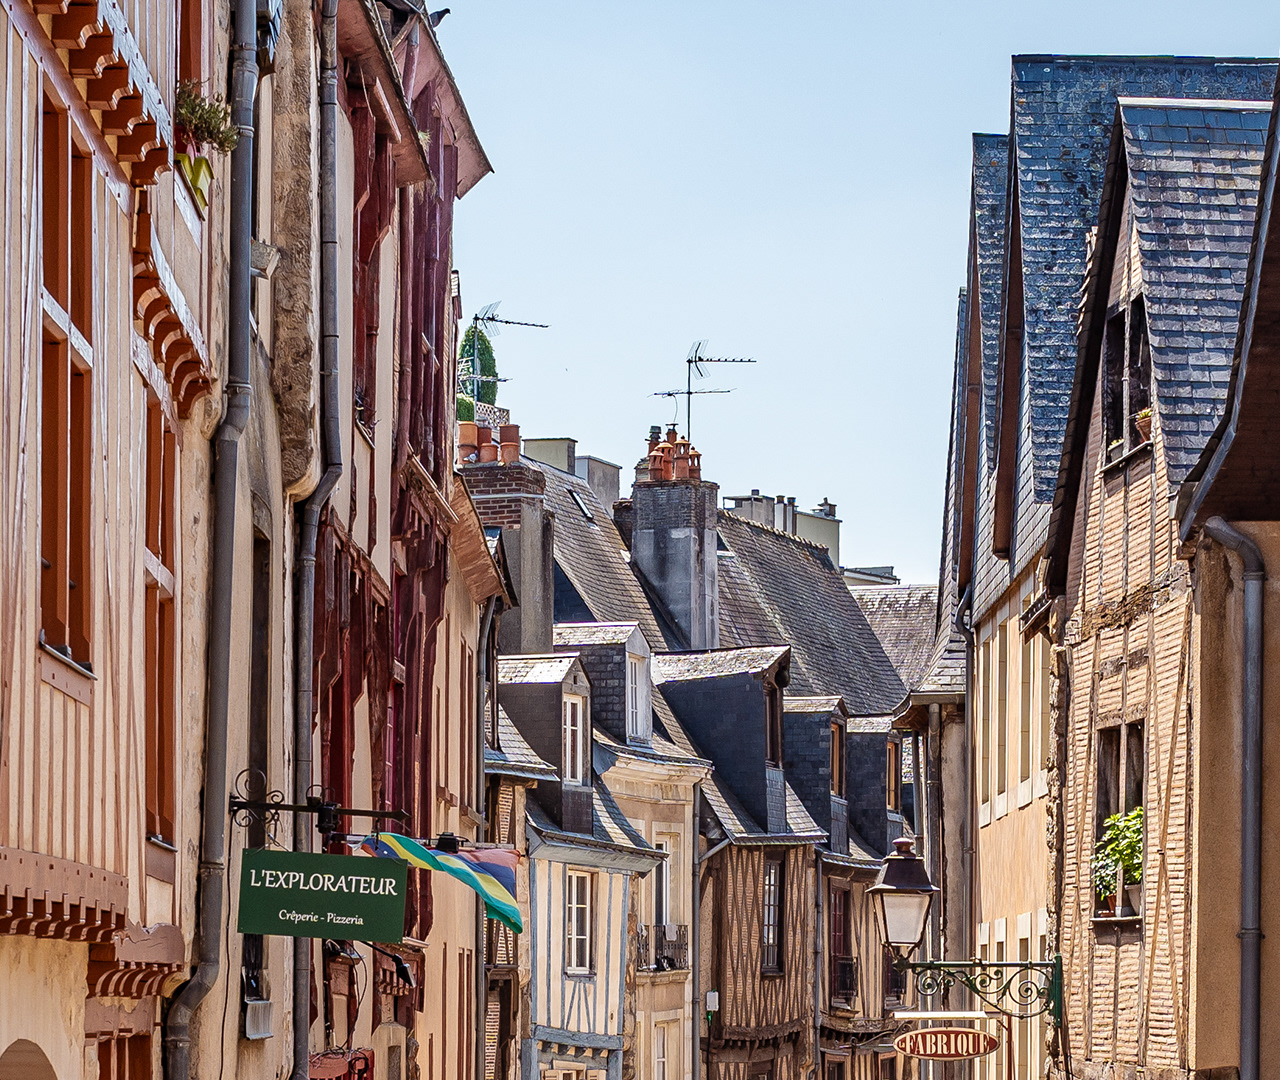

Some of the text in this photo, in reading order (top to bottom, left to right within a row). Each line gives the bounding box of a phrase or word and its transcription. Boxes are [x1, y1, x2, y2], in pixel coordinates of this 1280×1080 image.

[250, 869, 398, 896] L'EXPLORATEUR
[278, 909, 319, 924] Crêperie
[326, 912, 364, 926] Pizzeria
[905, 1033, 990, 1056] FABRIQUE
